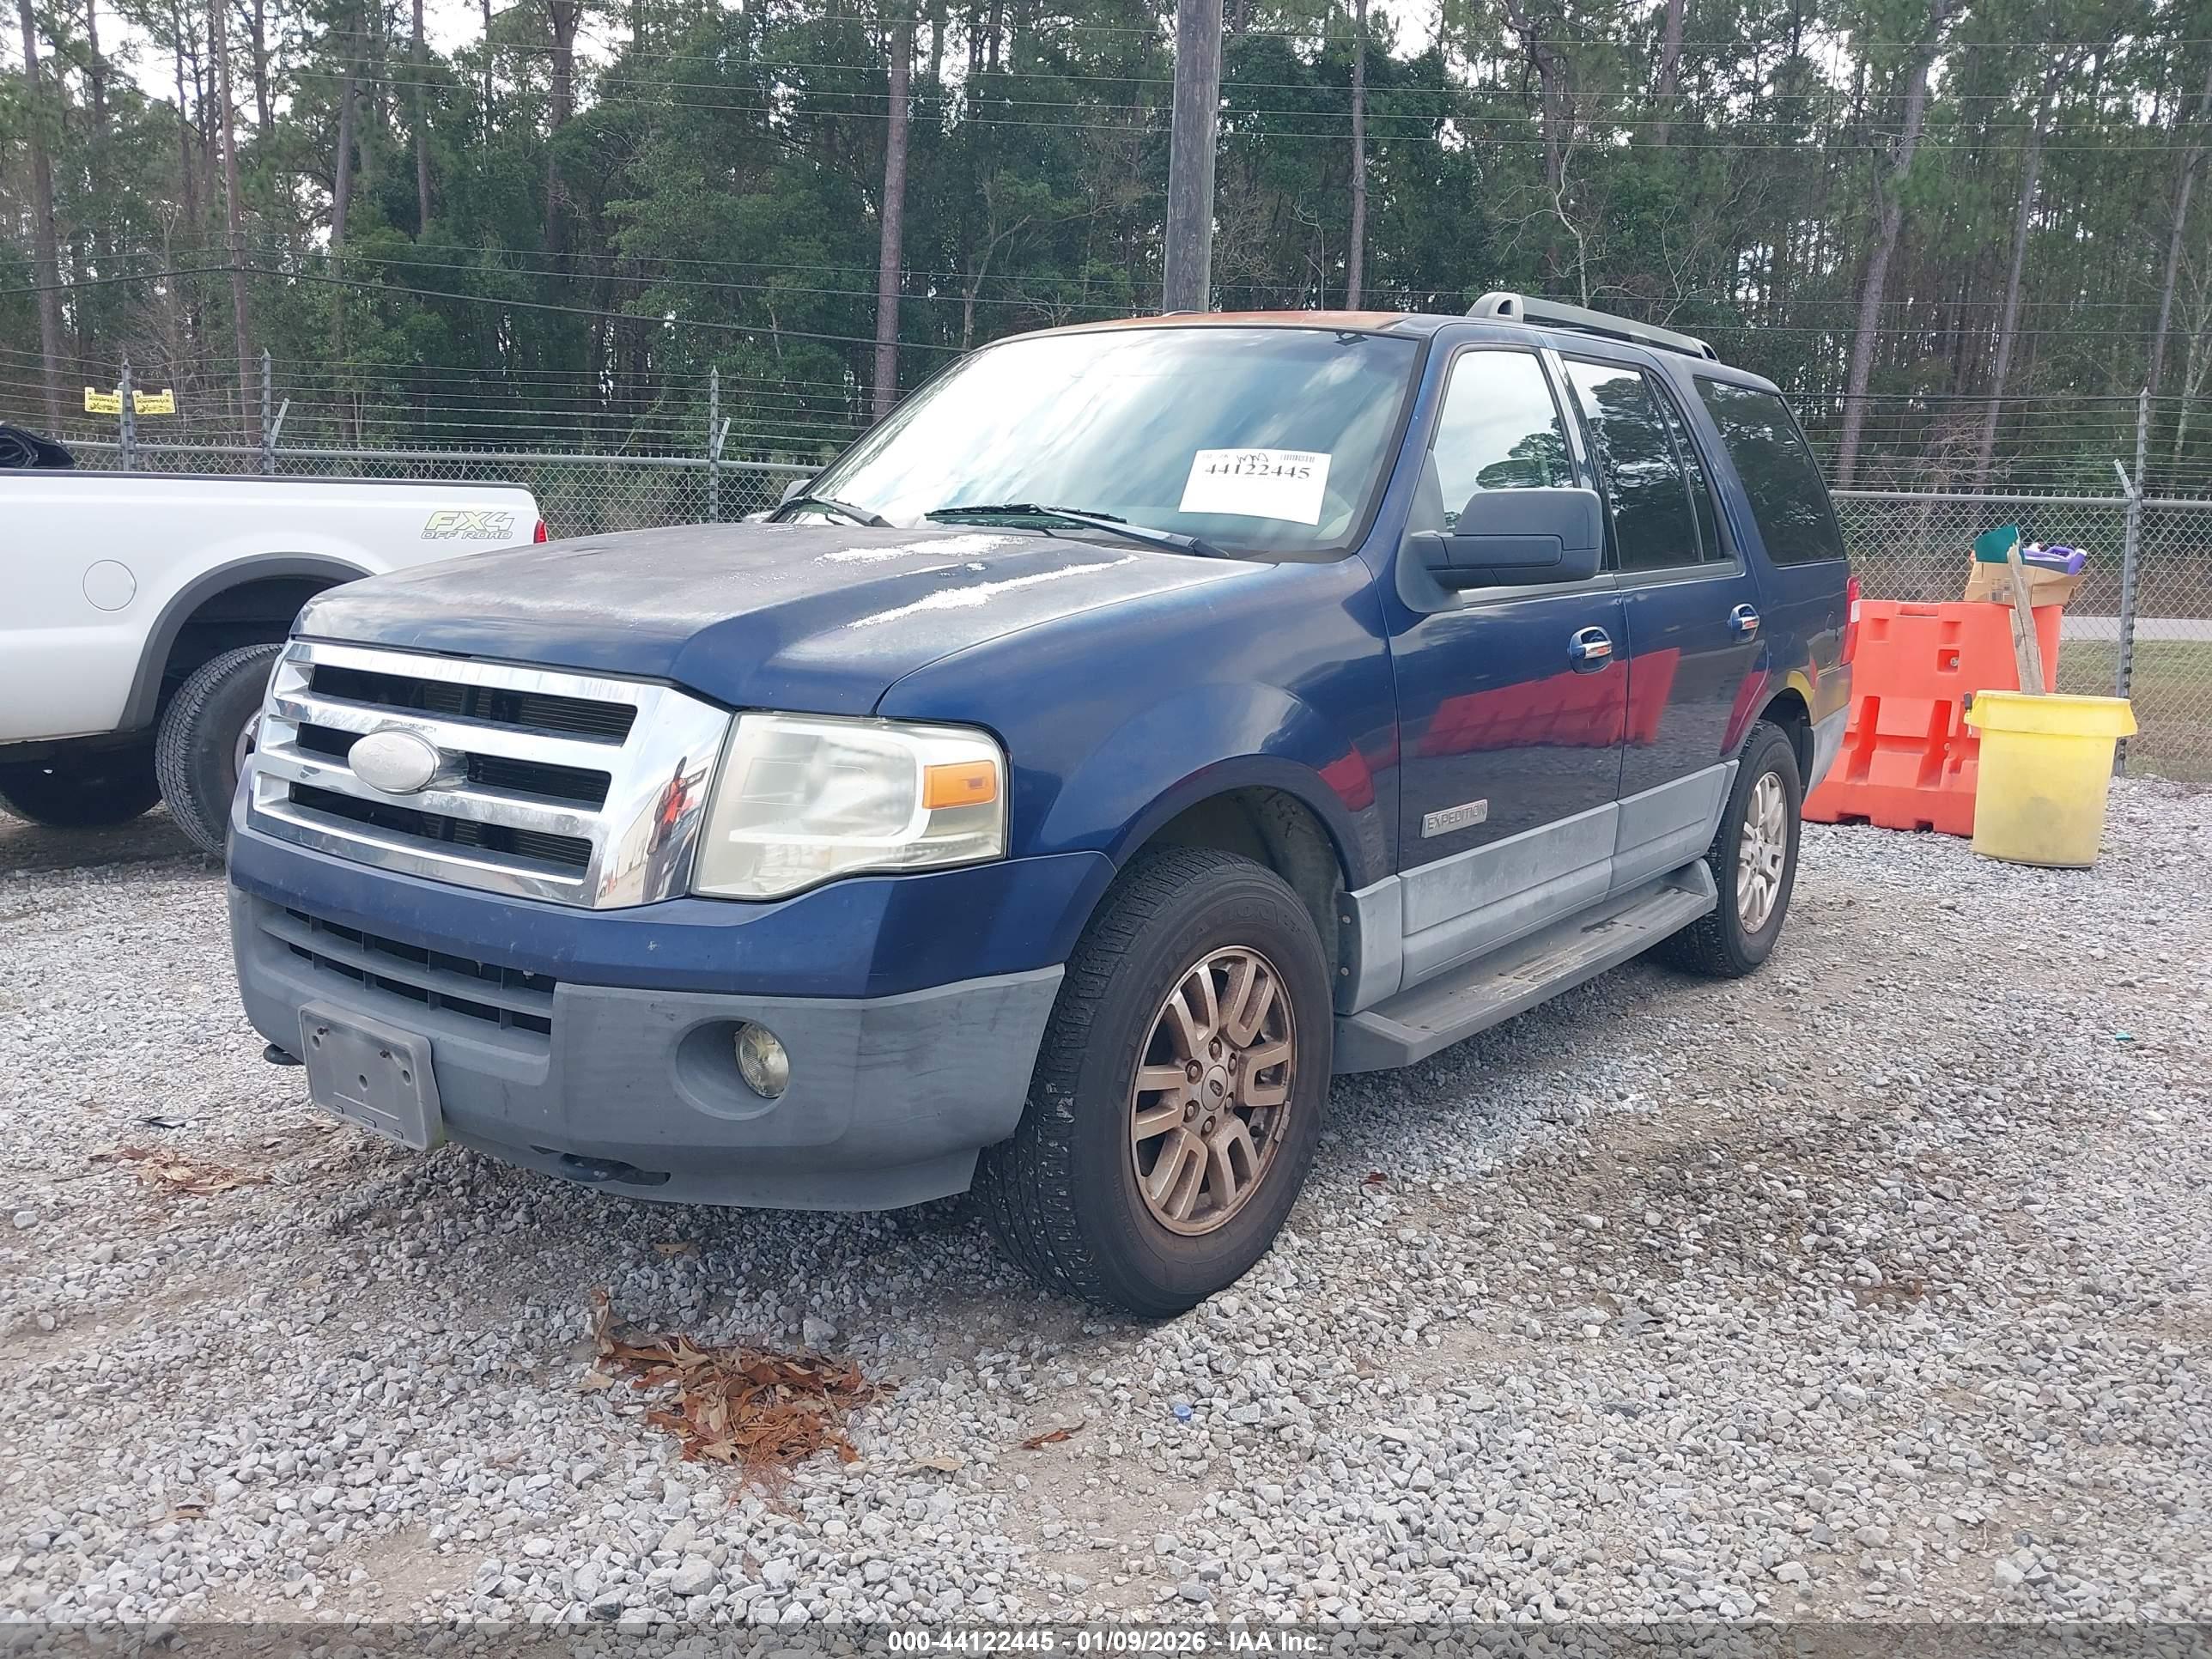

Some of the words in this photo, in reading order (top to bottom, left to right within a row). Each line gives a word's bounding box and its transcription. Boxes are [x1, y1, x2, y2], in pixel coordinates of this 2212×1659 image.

[1205, 464, 1311, 480] 44122445
[424, 510, 515, 531] FX4
[420, 531, 459, 540] OFF
[461, 531, 514, 540] ROAD
[1427, 802, 1486, 830] EXPEDITION
